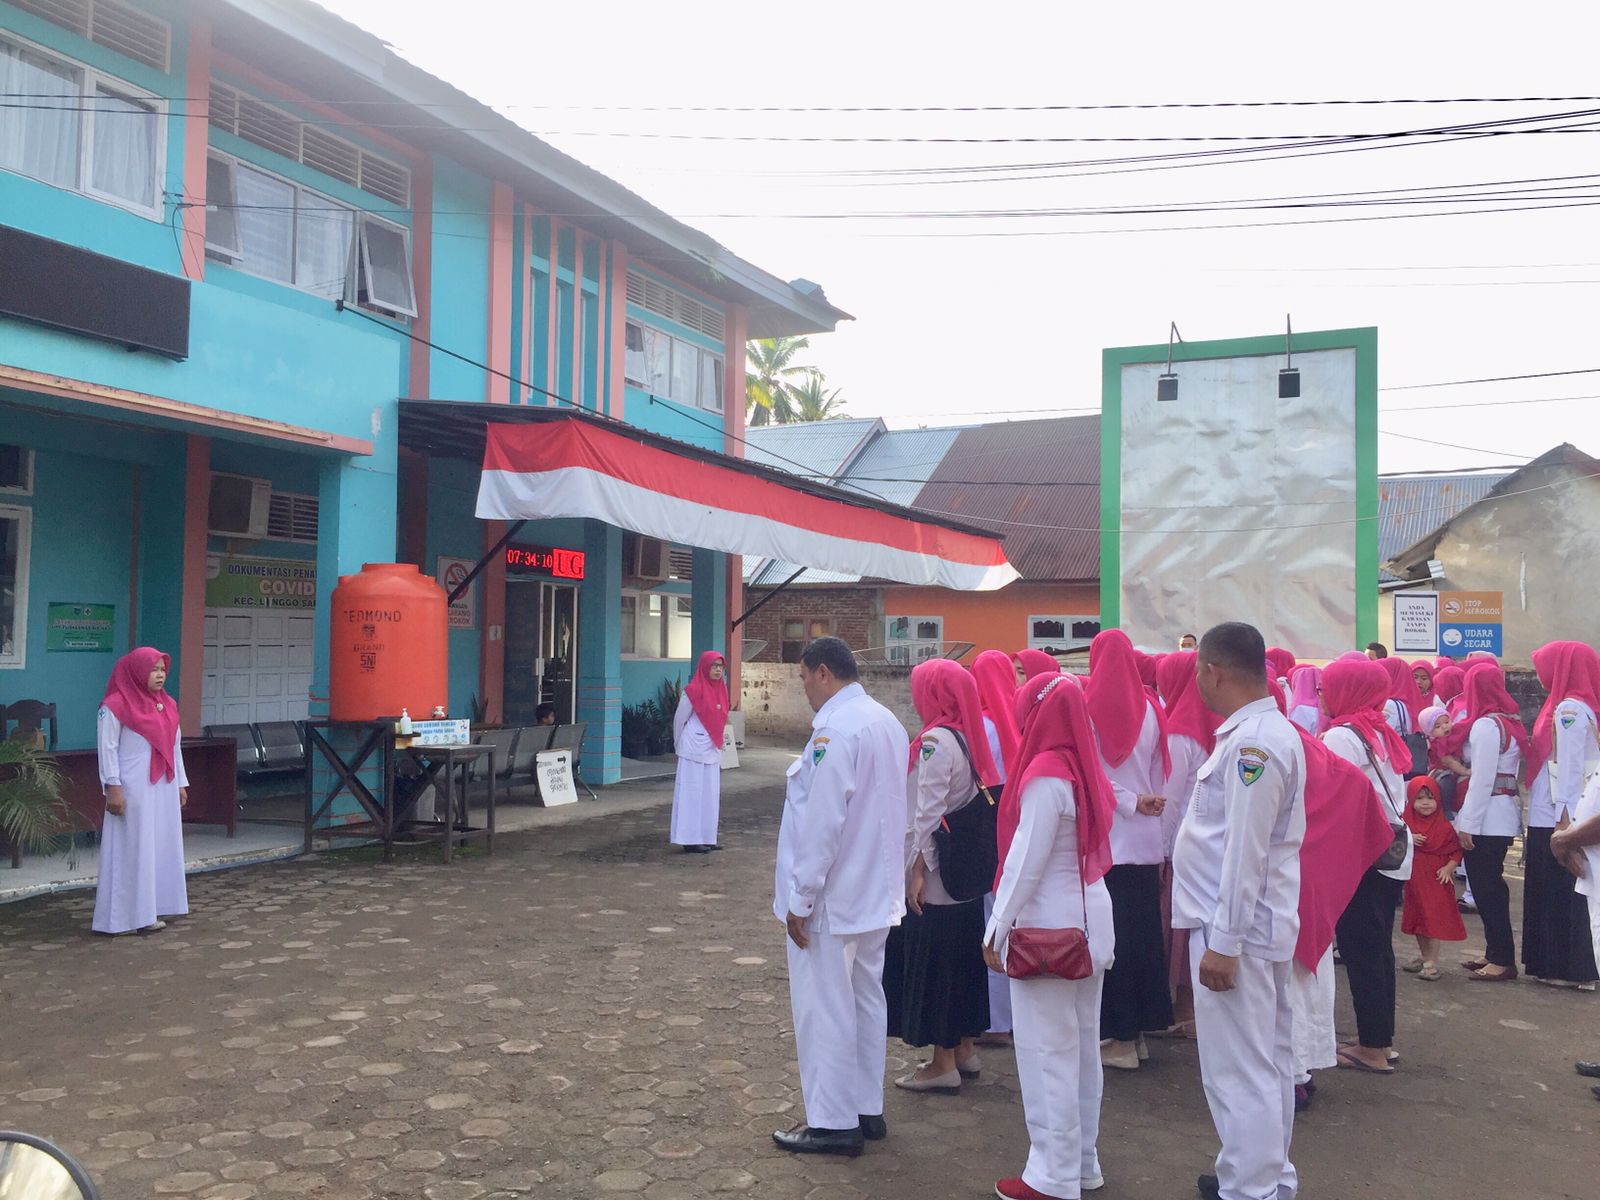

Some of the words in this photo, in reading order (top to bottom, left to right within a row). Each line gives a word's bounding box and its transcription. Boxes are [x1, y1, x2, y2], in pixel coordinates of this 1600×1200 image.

[507, 549, 552, 568] 07:34:10
[228, 565, 291, 577] DOKUMENTASI
[259, 580, 315, 595] COVID
[234, 597, 257, 606] KEC.
[260, 597, 299, 607] LINGGO
[1464, 630, 1493, 638] UDARA
[1464, 640, 1492, 648] SEGAR
[360, 655, 376, 666] SNI
